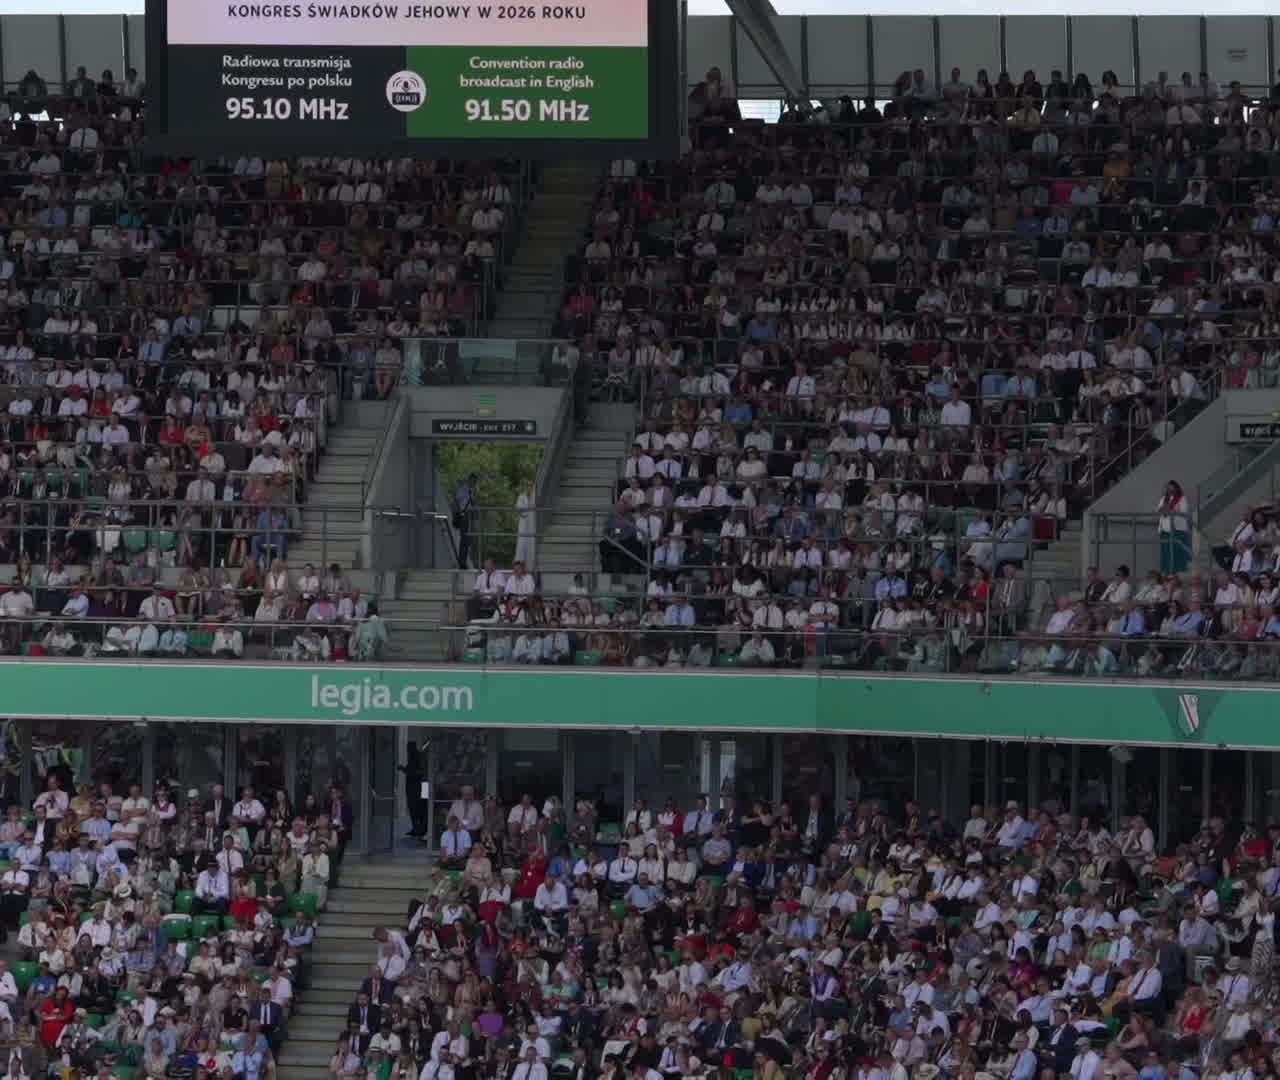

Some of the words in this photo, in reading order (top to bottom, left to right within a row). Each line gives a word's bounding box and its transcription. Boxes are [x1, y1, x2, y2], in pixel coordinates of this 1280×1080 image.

[228, 4, 302, 18] KONGRES
[307, 2, 398, 19] ŚWIADKÓW
[404, 5, 471, 19] JEHOWY
[478, 6, 492, 19] W
[497, 5, 536, 19] 2026
[542, 6, 586, 19] ROKU
[222, 54, 280, 68] Radiowa
[283, 56, 352, 71] transmisja
[469, 56, 546, 69] Convention
[549, 56, 584, 69] radio
[221, 73, 284, 90] Kongresu
[287, 77, 305, 90] po
[308, 73, 352, 90] polsku
[459, 73, 527, 88] broadcast
[530, 75, 542, 88] in
[546, 75, 594, 92] English
[225, 97, 291, 120] 95.10
[299, 98, 349, 120] MHz
[465, 98, 531, 121] 91.50
[539, 99, 590, 121] MHz
[311, 674, 474, 715] legia.com
